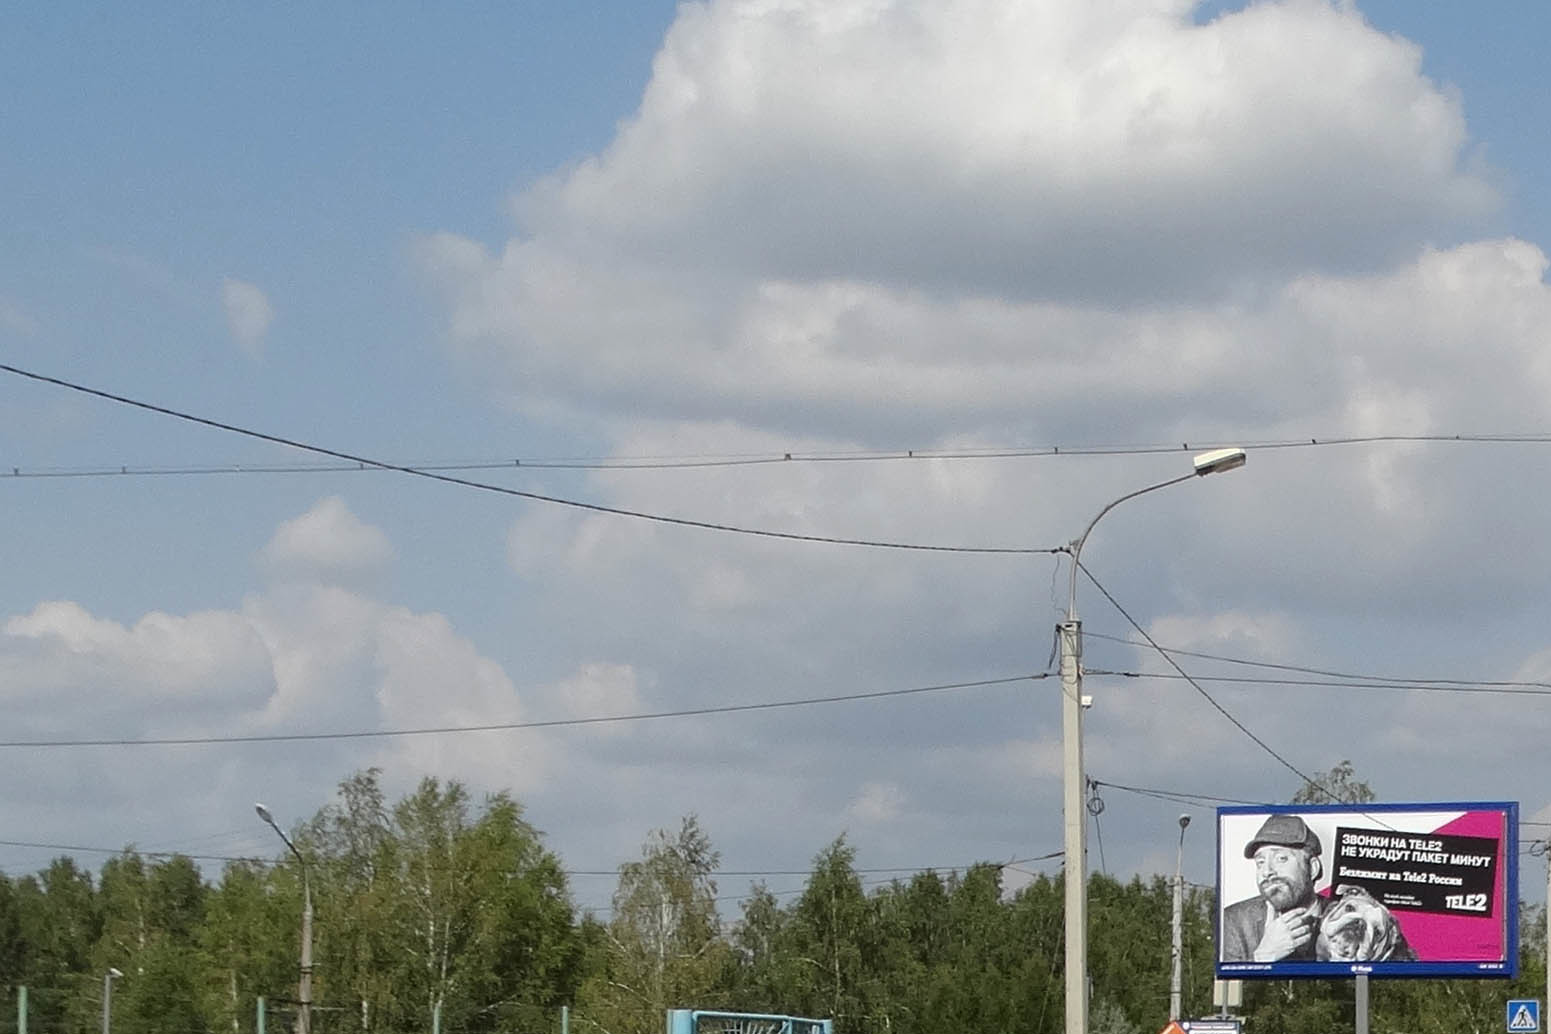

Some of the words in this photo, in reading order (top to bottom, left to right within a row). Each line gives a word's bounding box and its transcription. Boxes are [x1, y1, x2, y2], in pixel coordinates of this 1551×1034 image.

[1342, 834, 1389, 847] ЗВОНКИ
[1391, 838, 1407, 849] НА
[1409, 839, 1442, 851] TELE2
[1341, 846, 1357, 857] НЕ
[1359, 848, 1410, 862] УКРАДУТ
[1412, 851, 1449, 864] ПАКЕТ
[1450, 855, 1491, 868] МИНУТ
[1389, 872, 1401, 881] на
[1403, 872, 1427, 883] Tele2
[1428, 874, 1463, 886] России
[1446, 894, 1487, 912] TELE2
